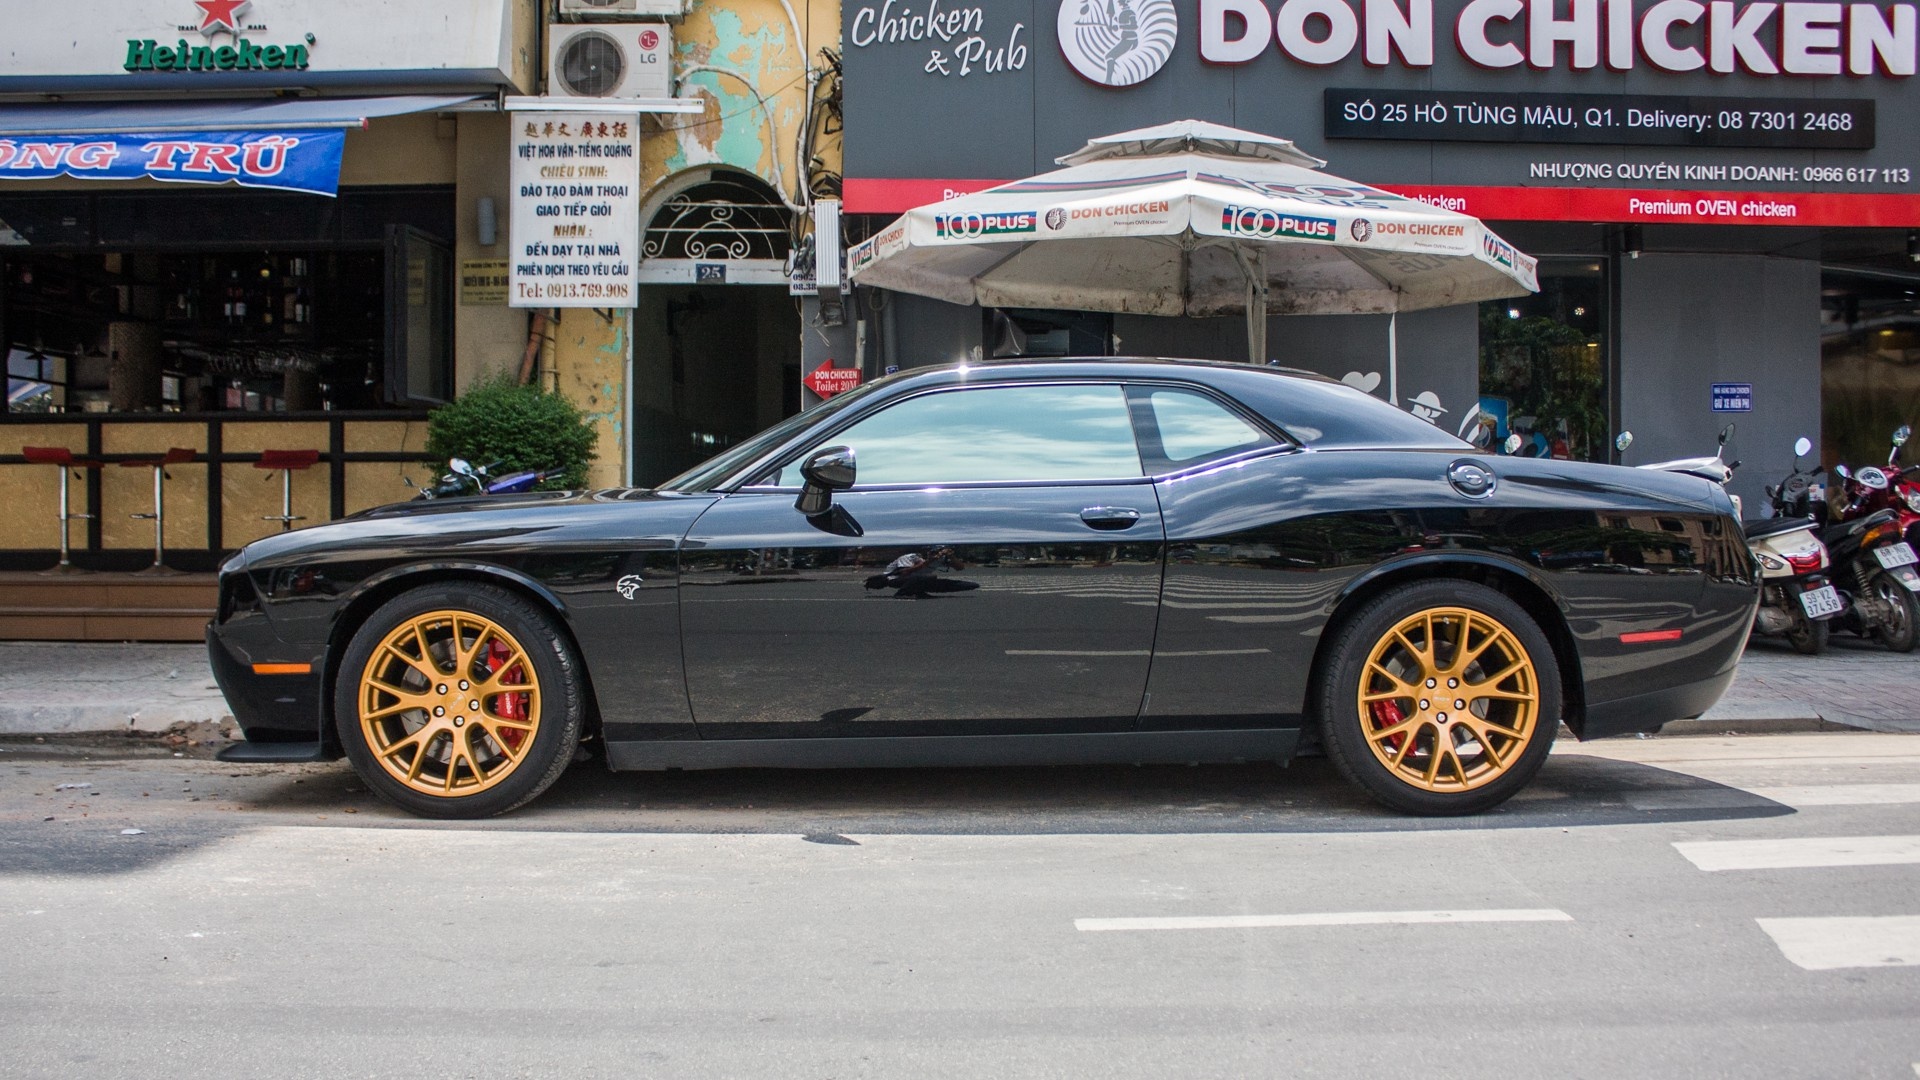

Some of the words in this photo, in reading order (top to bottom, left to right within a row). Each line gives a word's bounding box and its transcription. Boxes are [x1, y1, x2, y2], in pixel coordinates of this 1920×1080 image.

[852, 0, 983, 47] Chicken
[1198, 0, 1433, 67] DON
[1454, 0, 1917, 76] CHICKEN
[124, 38, 310, 71] Heineken
[641, 54, 657, 64] LG
[924, 50, 950, 76] &
[955, 23, 1027, 77] Pub
[1344, 99, 1376, 122] SỐ
[1382, 103, 1408, 122] 25
[1414, 101, 1447, 123] HỒ
[1453, 102, 1516, 125] TÙNG
[1523, 105, 1578, 128] MẬU,
[1585, 108, 1620, 127] Q1.
[1627, 109, 1712, 133] Delivery:
[1718, 111, 1743, 129] 08
[1749, 112, 1795, 130] 7301
[1803, 112, 1852, 131] 2468
[141, 135, 299, 177] TRỨ
[578, 165, 608, 177] SINH:
[1530, 162, 1612, 181] NHƯỢNG
[1684, 165, 1727, 180] KINH
[1731, 165, 1799, 182] DOANH:
[1803, 167, 1844, 182] 0966
[1846, 168, 1877, 182] 617
[1881, 168, 1910, 183] 113
[521, 183, 543, 197] ĐÀO
[546, 185, 566, 199] TẠO
[570, 183, 593, 197] ĐÀM
[597, 185, 628, 199] THOẠI
[536, 204, 560, 216] GIAO
[564, 201, 587, 216] TIẾP
[1071, 207, 1101, 219] DON
[1104, 201, 1169, 216] CHICKEN
[1629, 198, 1692, 215] Premium
[1696, 200, 1737, 216] OVEN
[1741, 201, 1796, 217] chicken
[938, 211, 983, 240] 100
[986, 214, 1030, 231] PLUS
[1229, 204, 1279, 238] 100
[1282, 217, 1330, 236] PLUS
[1377, 222, 1406, 234] DON
[1409, 224, 1464, 236] CHICKEN
[526, 241, 548, 256] ĐẾN
[552, 245, 573, 259] DẠY
[577, 245, 595, 259] TẠI
[598, 242, 620, 256] NHÀ
[545, 264, 565, 278] DỊCH
[568, 264, 590, 276] THEO
[701, 266, 721, 279] 25
[517, 282, 543, 298] Tel:
[547, 283, 628, 298] 0913.769.908
[815, 371, 830, 380] DON
[830, 370, 857, 380] CHICKEN
[815, 380, 839, 392] Toilet
[1805, 588, 1833, 604] 59-V2
